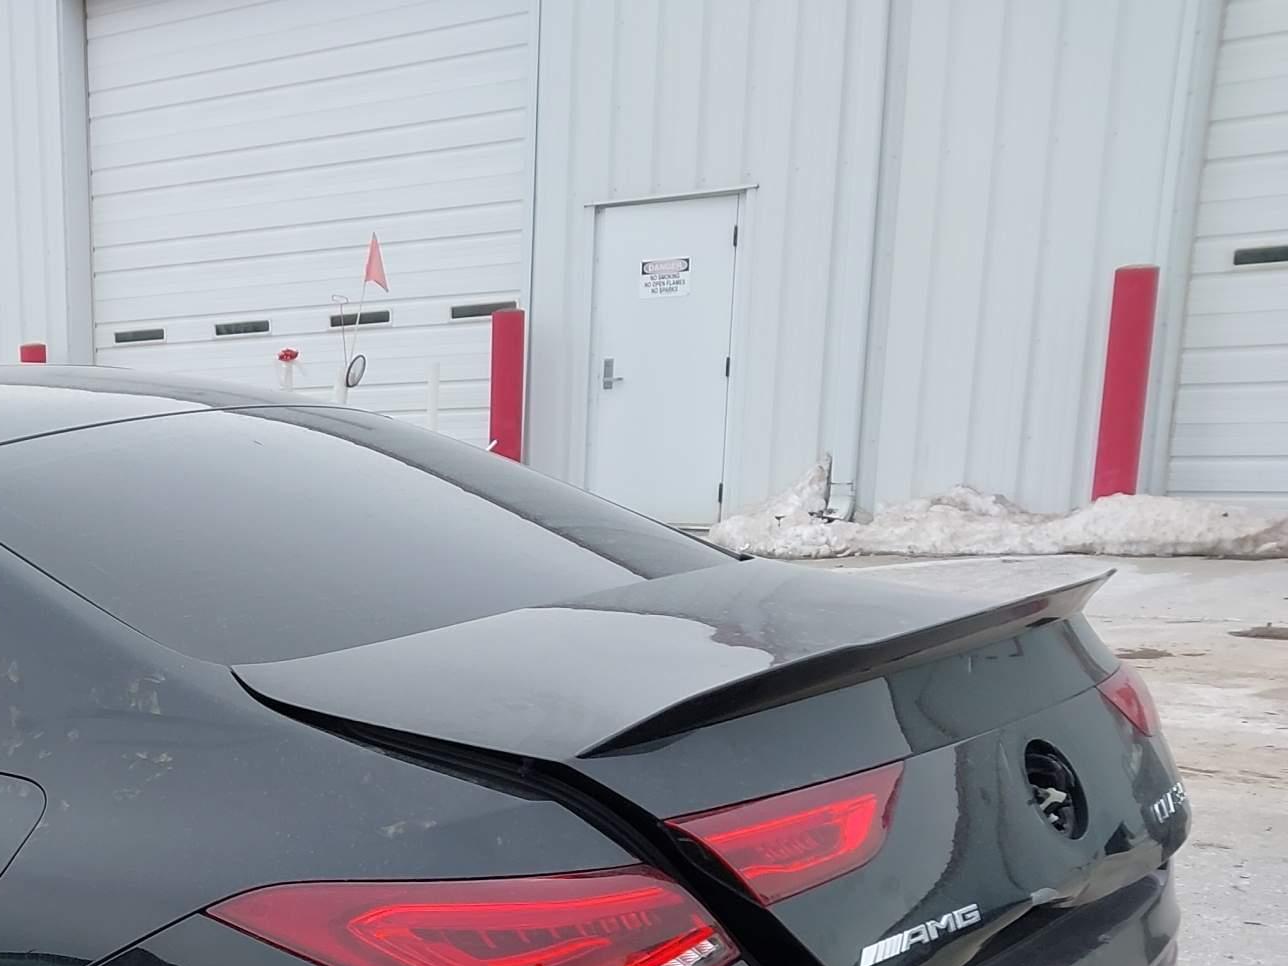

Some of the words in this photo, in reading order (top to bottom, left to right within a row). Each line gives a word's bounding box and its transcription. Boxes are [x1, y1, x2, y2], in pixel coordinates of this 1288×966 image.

[648, 261, 681, 273] DANGER
[652, 280, 665, 288] OPEN
[659, 286, 678, 294] SPARKS
[901, 903, 982, 953] AMG
